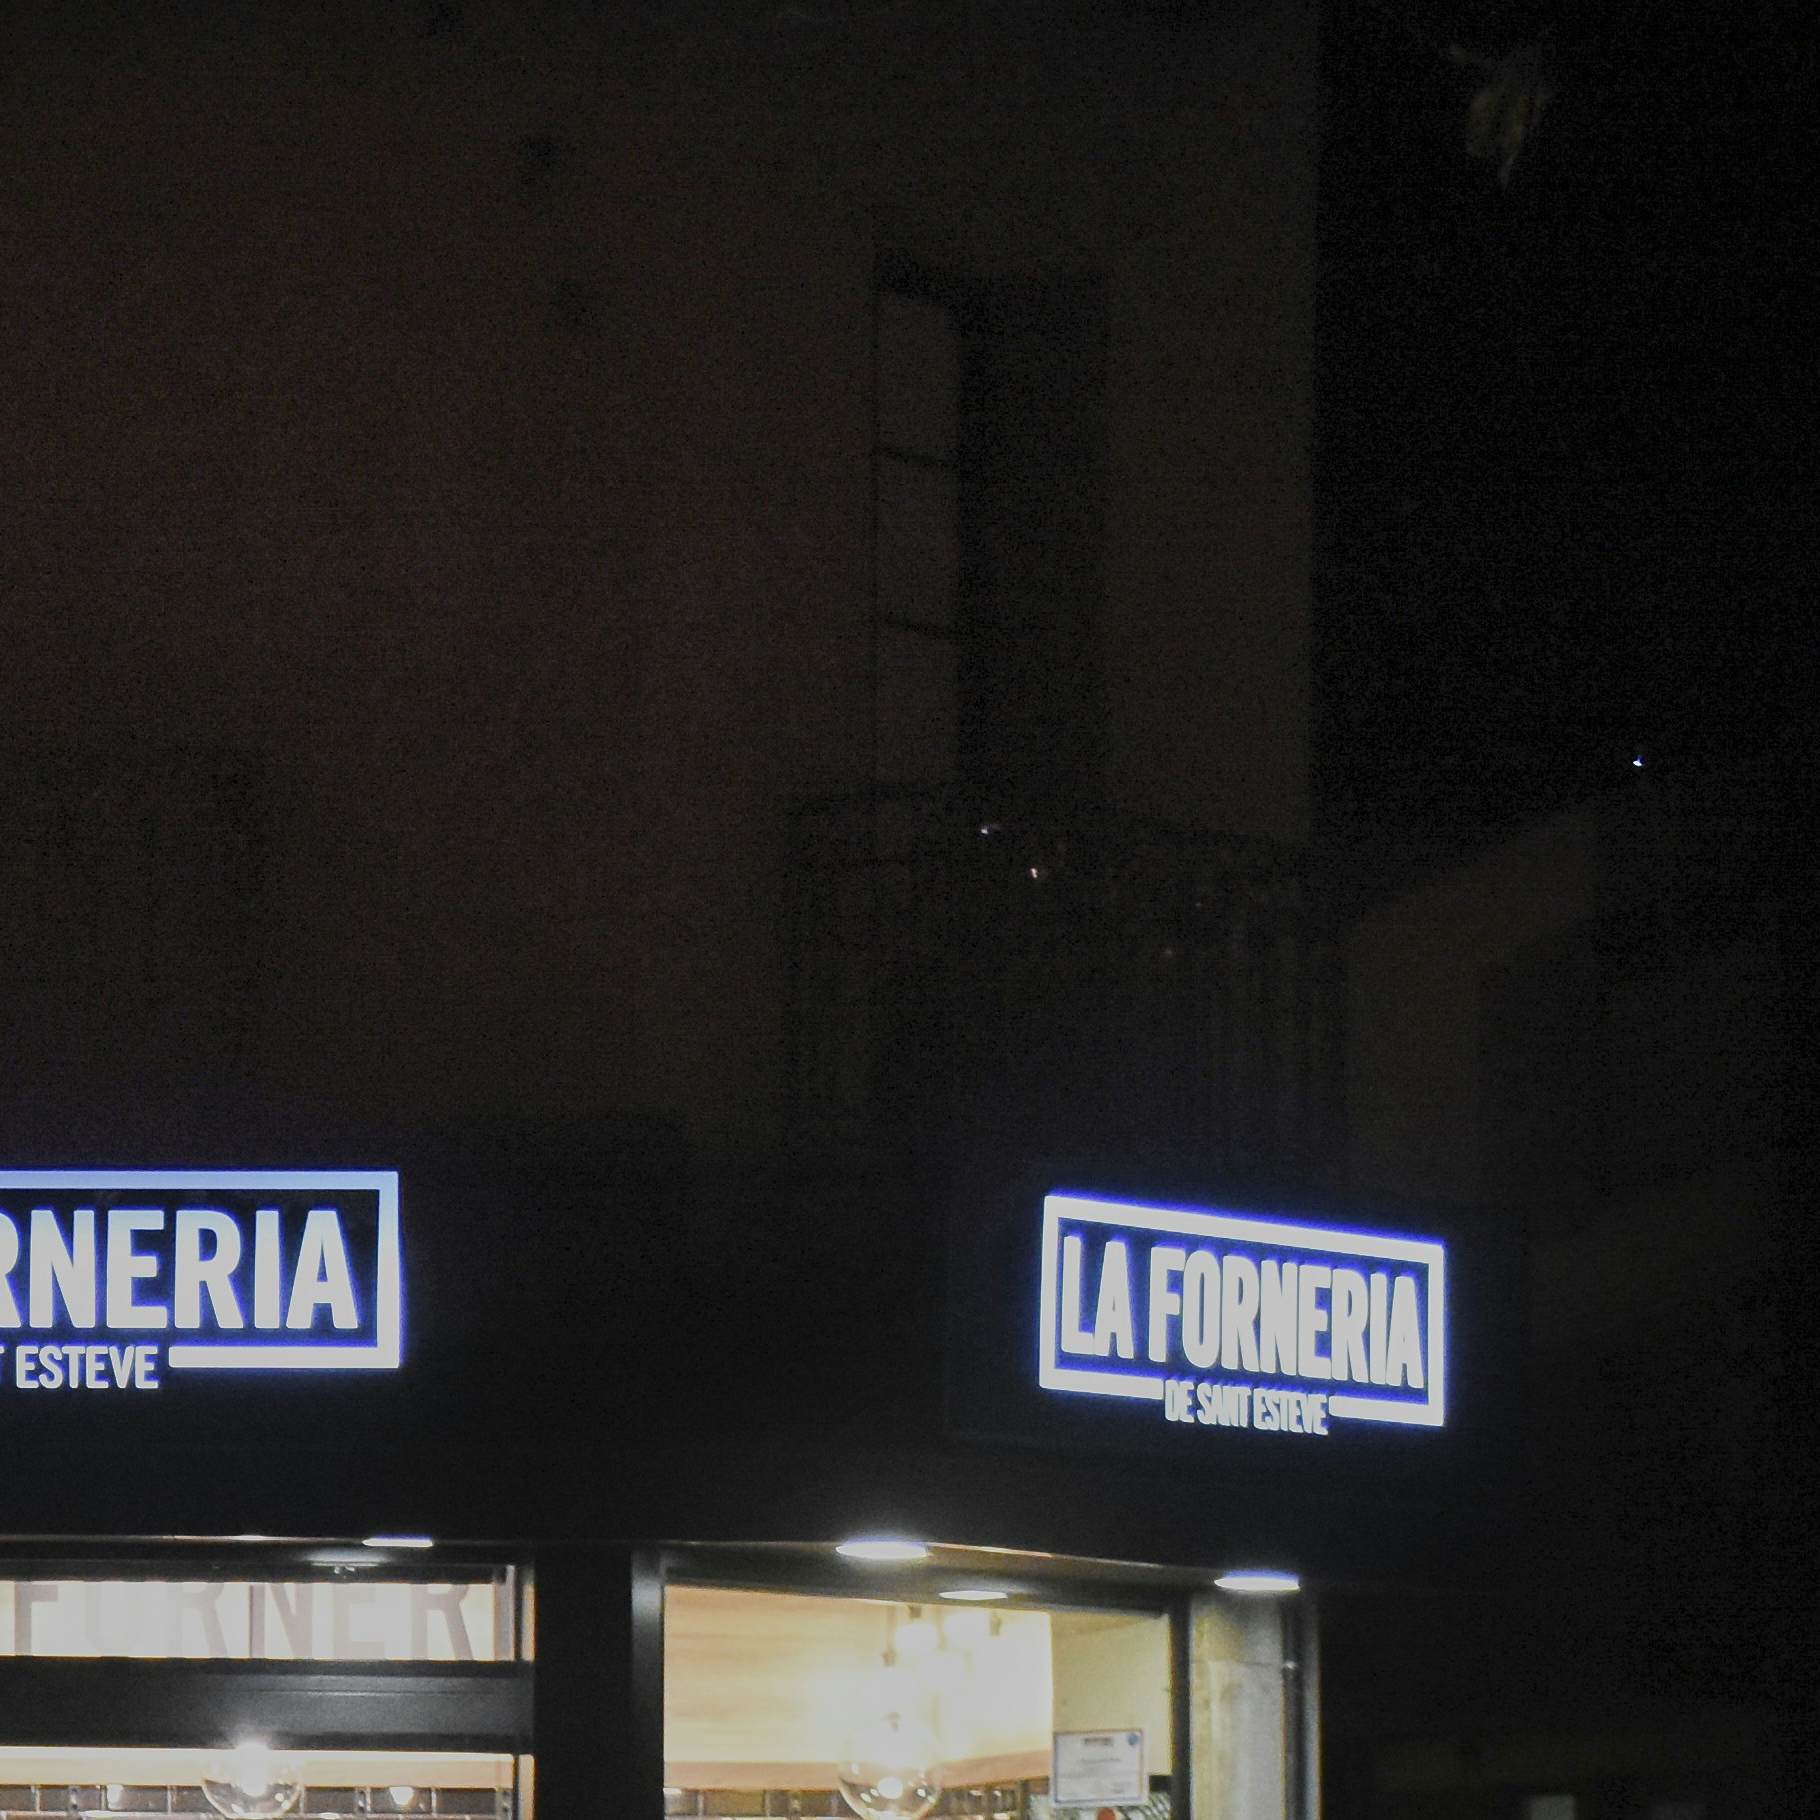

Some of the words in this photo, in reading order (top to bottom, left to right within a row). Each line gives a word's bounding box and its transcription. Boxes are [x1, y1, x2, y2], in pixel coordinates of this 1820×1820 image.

[1061, 1235, 1134, 1359] LA
[1148, 1246, 1424, 1388] FORNERIA
[16, 1347, 159, 1389] ESTEVE
[1165, 1381, 1195, 1423] DE
[1197, 1384, 1251, 1430] SANT
[1253, 1389, 1329, 1435] ESTEVE
